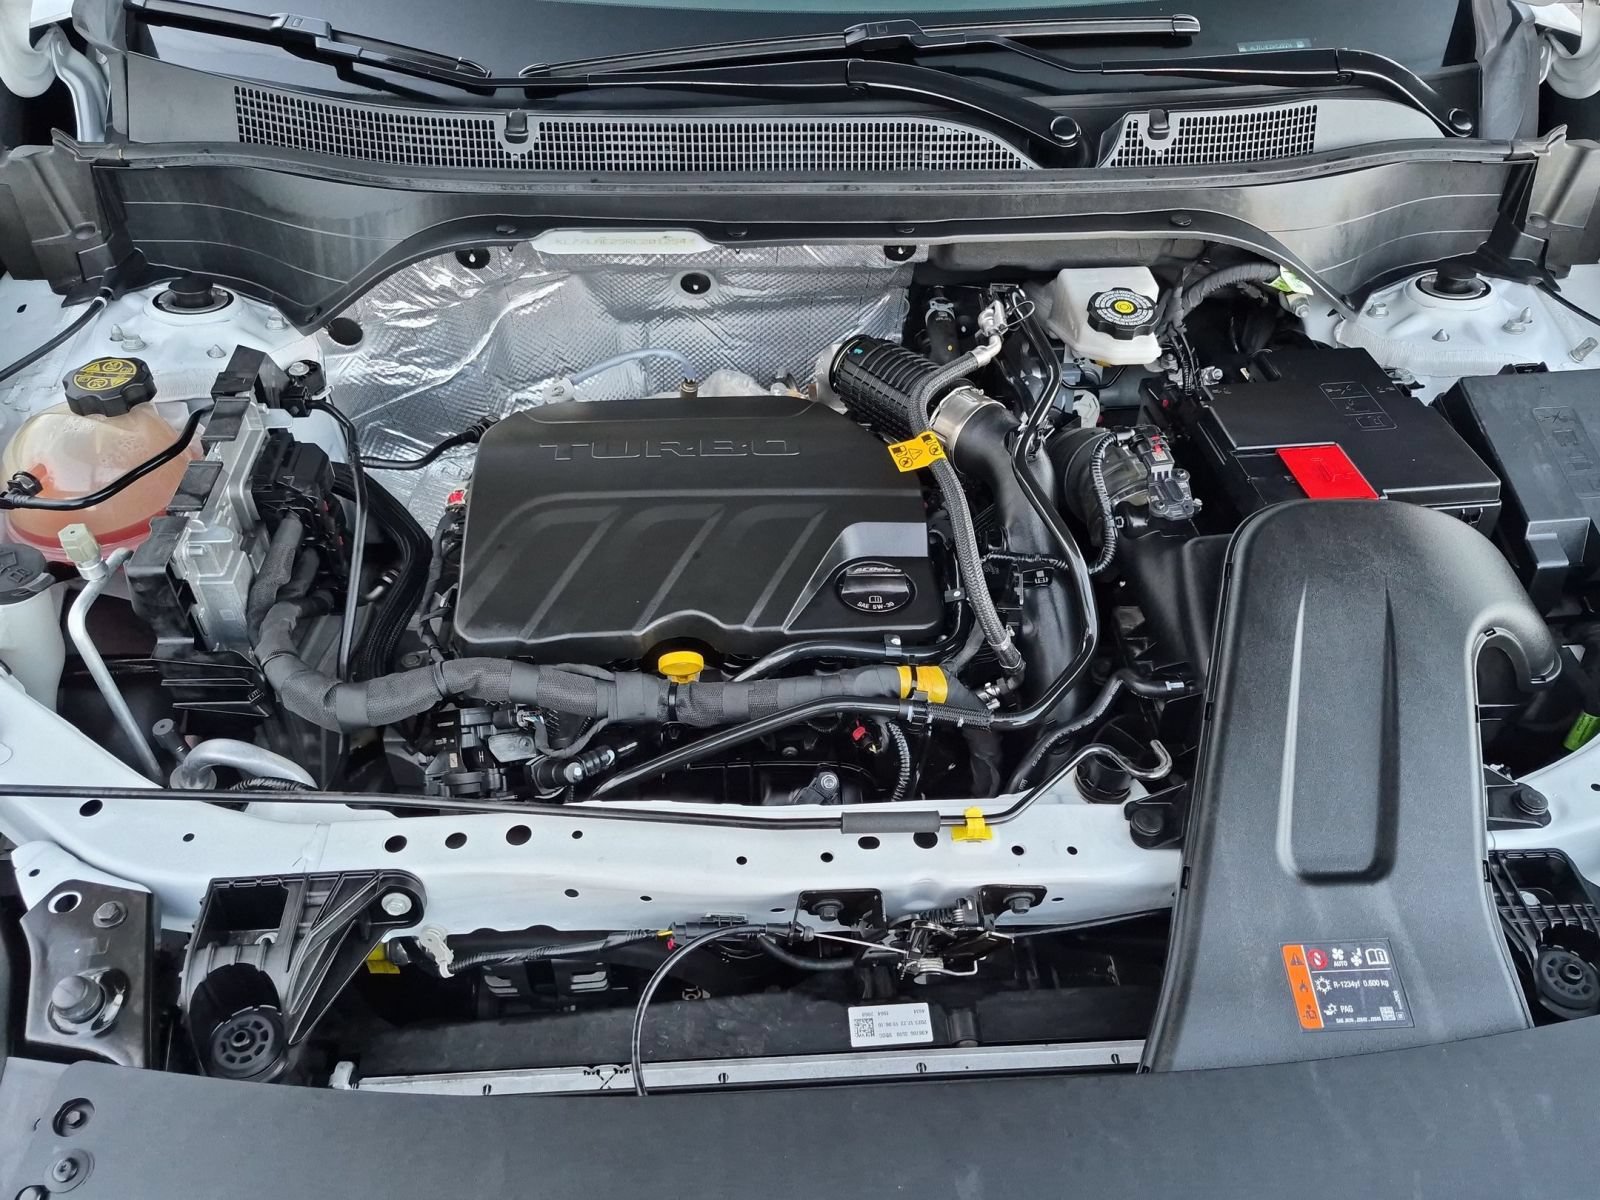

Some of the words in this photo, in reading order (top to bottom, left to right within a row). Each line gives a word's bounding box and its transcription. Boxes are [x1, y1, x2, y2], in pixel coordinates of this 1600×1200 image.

[538, 439, 800, 461] TURBO
[1333, 980, 1360, 989] R-1234yf
[1380, 979, 1389, 988] kg
[1340, 1005, 1354, 1014] PAG
